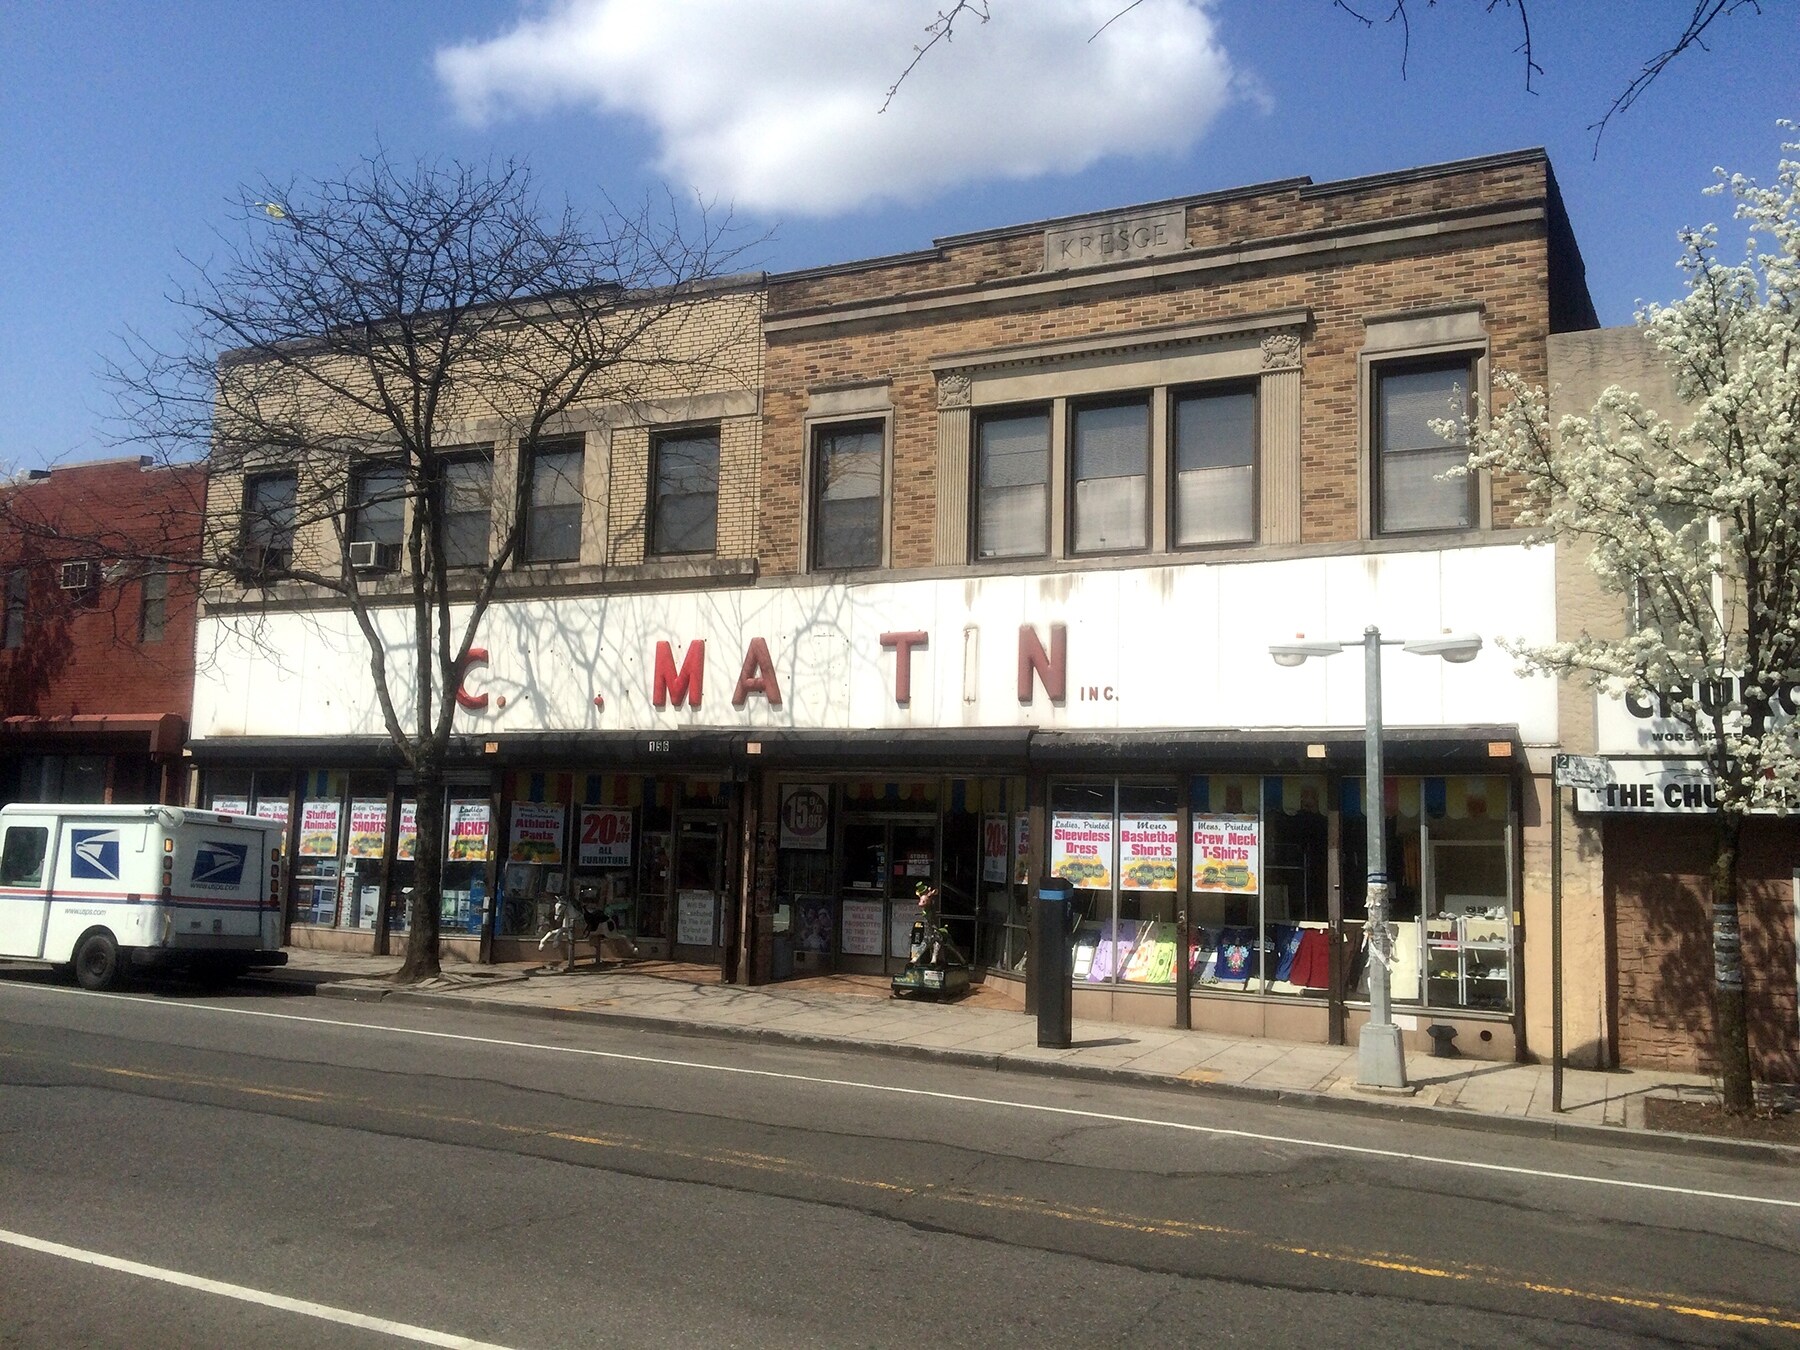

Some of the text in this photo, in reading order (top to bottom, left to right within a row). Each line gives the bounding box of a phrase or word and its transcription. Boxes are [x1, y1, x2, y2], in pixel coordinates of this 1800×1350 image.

[1060, 223, 1168, 261] KRESGE
[1081, 686, 1120, 702] INC.
[650, 741, 670, 752] 156
[1559, 755, 1568, 768] 2
[306, 810, 336, 820] Stuffed
[304, 820, 337, 830] Animals
[515, 818, 560, 829] Athletic
[808, 814, 823, 828] OFF
[1083, 821, 1110, 830] Printed
[1137, 821, 1168, 830] Mens
[1224, 822, 1253, 831] Printed
[352, 821, 387, 833] SHORTS
[520, 830, 554, 841] Pants
[615, 832, 631, 844] OFF
[1054, 829, 1111, 843] Sleeveless
[1194, 831, 1257, 846] Crew Neck
[598, 846, 612, 855] ALL
[1066, 842, 1098, 855] Dress
[1131, 843, 1172, 856] Shorts
[1202, 846, 1249, 860] T-Shirts
[581, 856, 629, 865] FURNITURE
[190, 883, 240, 891] www.usps.com
[65, 908, 107, 916] www.usps.com
